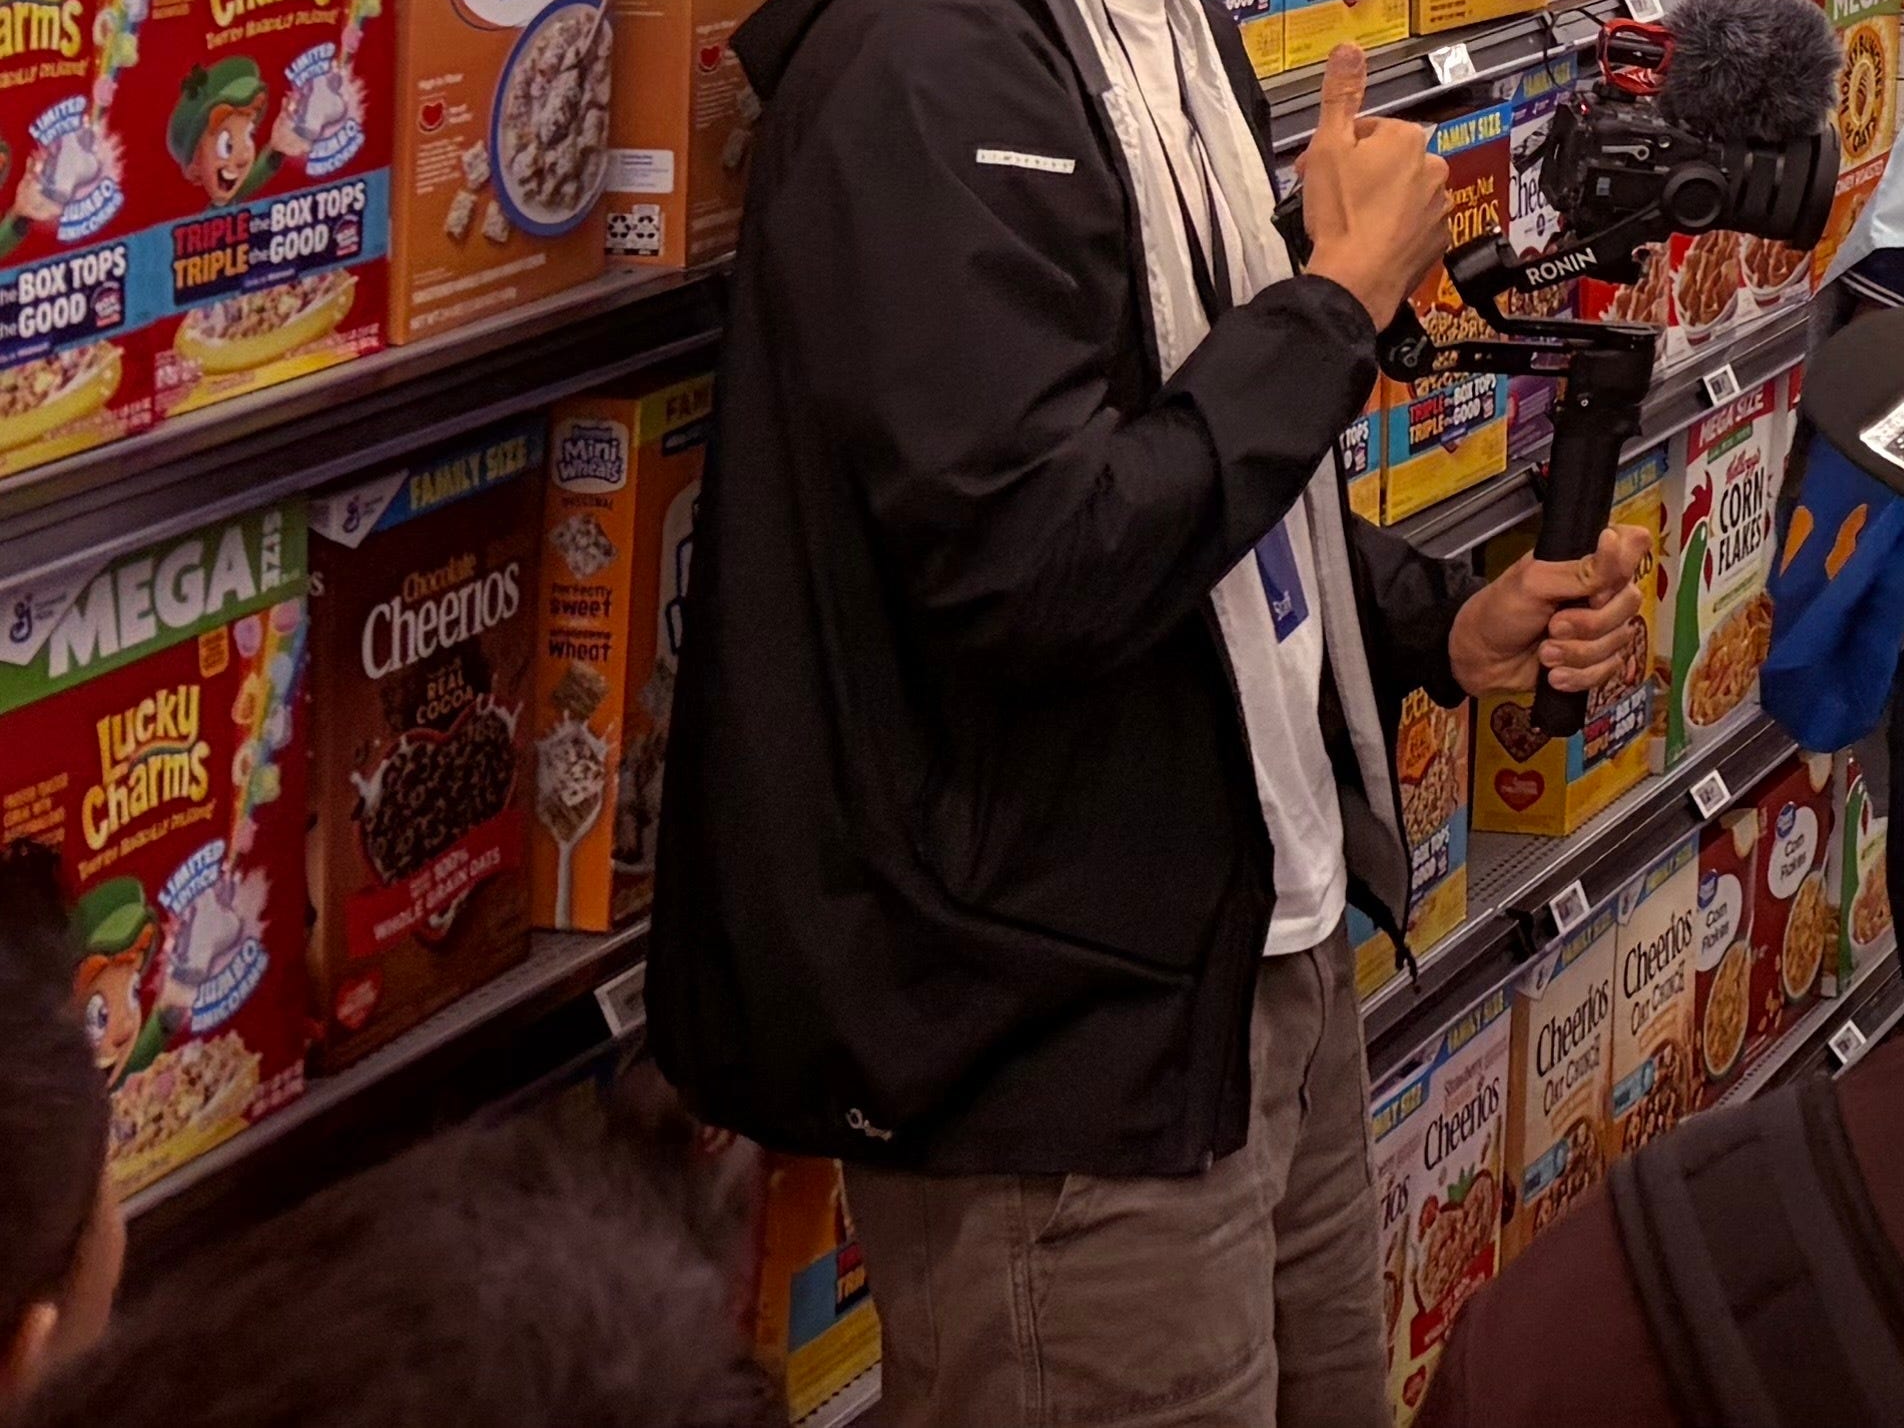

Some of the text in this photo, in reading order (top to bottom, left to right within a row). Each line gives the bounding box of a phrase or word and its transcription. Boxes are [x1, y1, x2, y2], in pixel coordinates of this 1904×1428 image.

[1525, 247, 1598, 286] RONIN
[1719, 466, 1764, 521] CORN
[403, 551, 478, 604] Chocolate
[1718, 520, 1764, 577] FLAKES
[47, 523, 262, 679] MEGA
[361, 562, 522, 681] Cheerios
[96, 686, 201, 784] Lucky
[82, 741, 211, 851] Charms
[1622, 907, 1694, 1000] Cheerios
[1423, 1075, 1502, 1172] Cheerios
